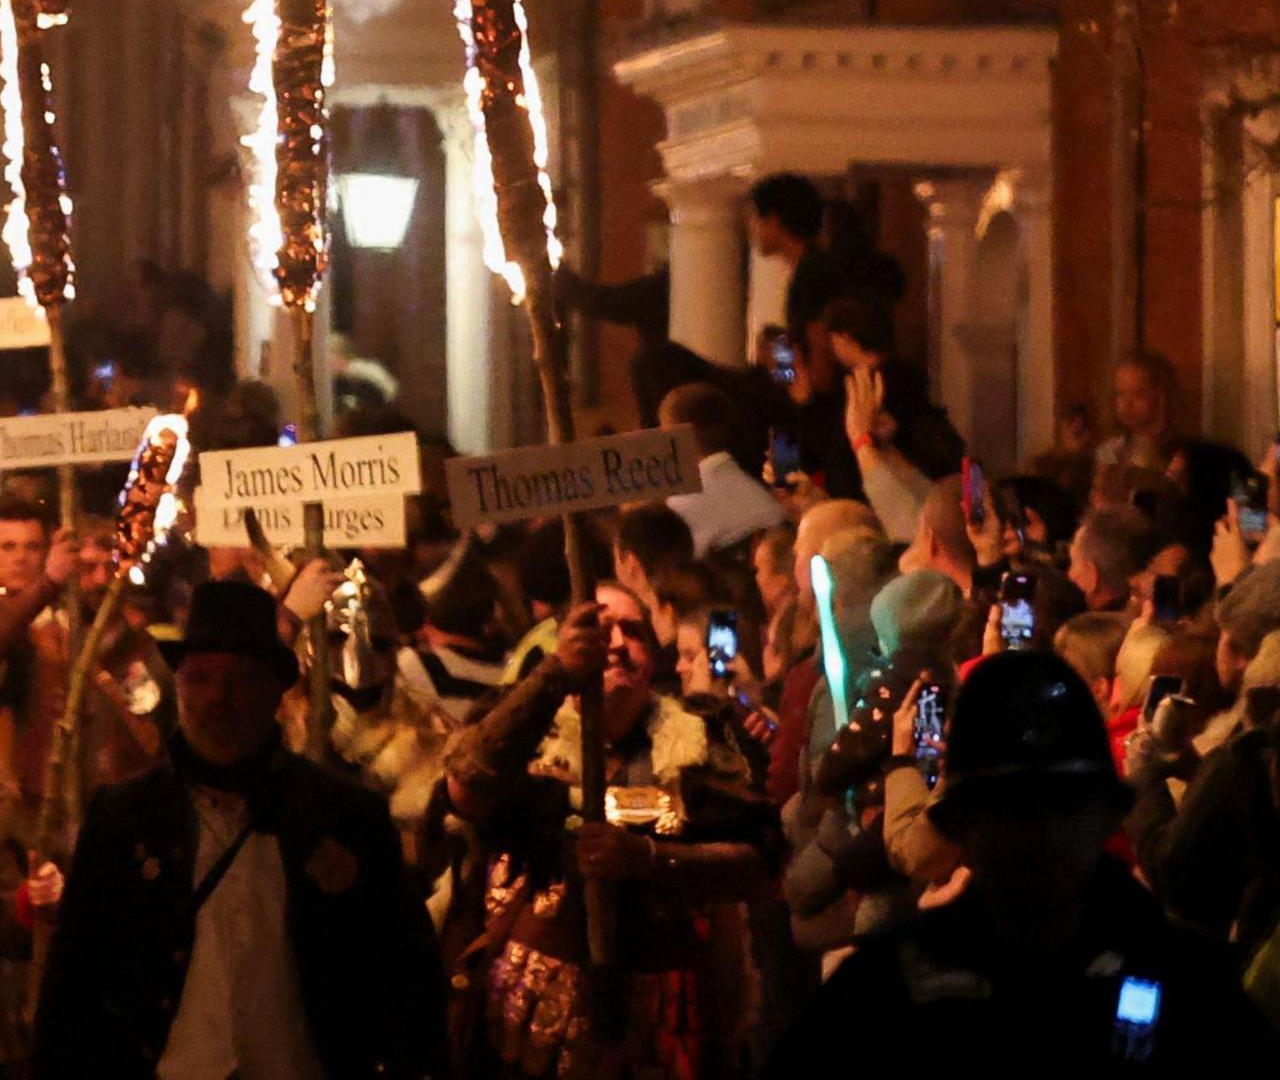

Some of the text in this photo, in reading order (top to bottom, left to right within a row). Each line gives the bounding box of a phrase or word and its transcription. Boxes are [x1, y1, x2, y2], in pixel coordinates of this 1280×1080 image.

[224, 445, 401, 500] James Morris
[468, 437, 684, 512] Thomas Reed
[325, 507, 384, 539] urges
